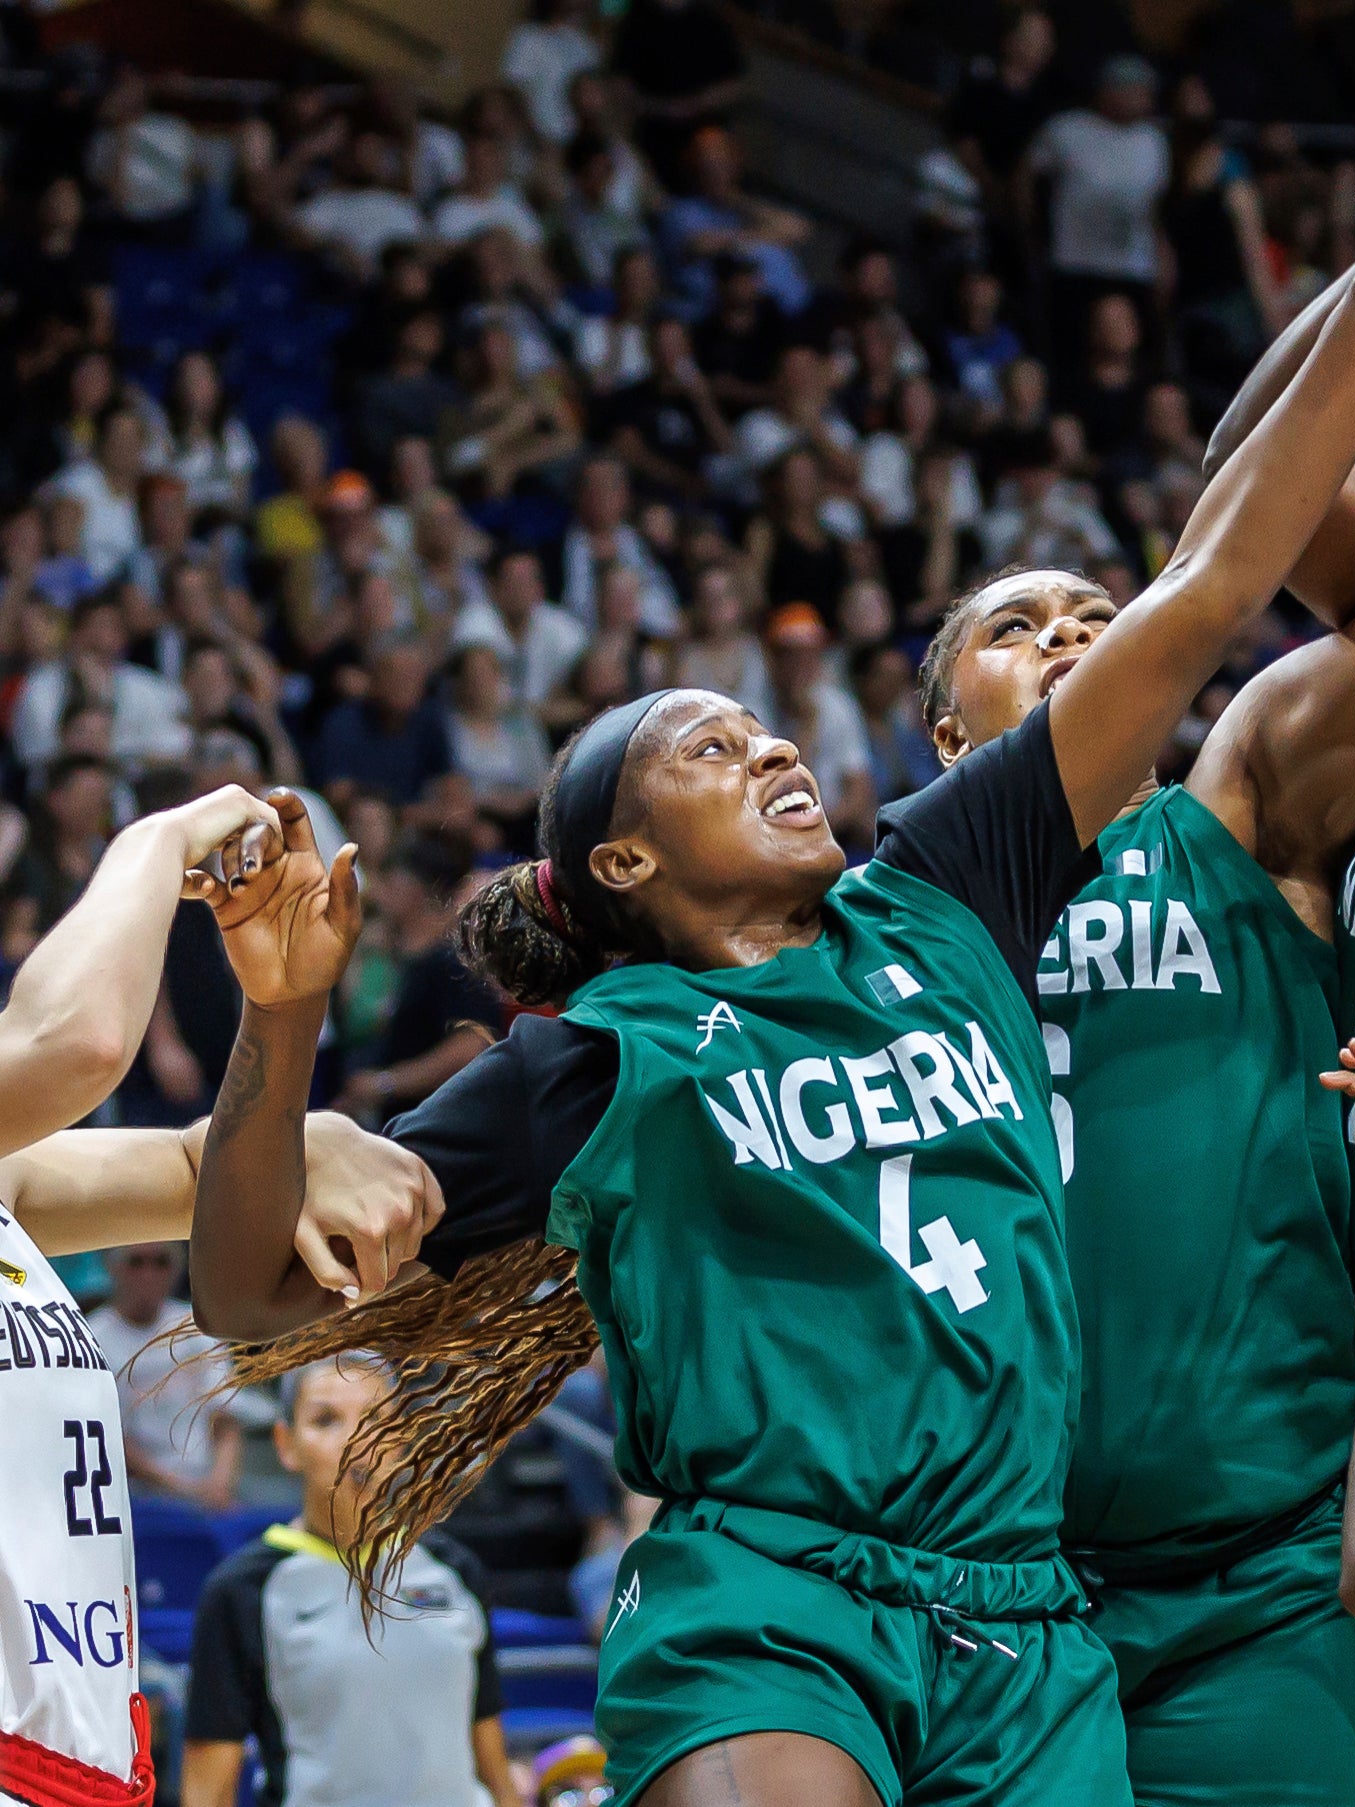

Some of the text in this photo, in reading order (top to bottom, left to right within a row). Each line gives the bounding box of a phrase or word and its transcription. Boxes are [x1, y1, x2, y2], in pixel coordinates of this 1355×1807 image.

[704, 1021, 1024, 1172] NIGERIA
[879, 1153, 991, 1314] 4
[63, 1420, 122, 1537] 22
